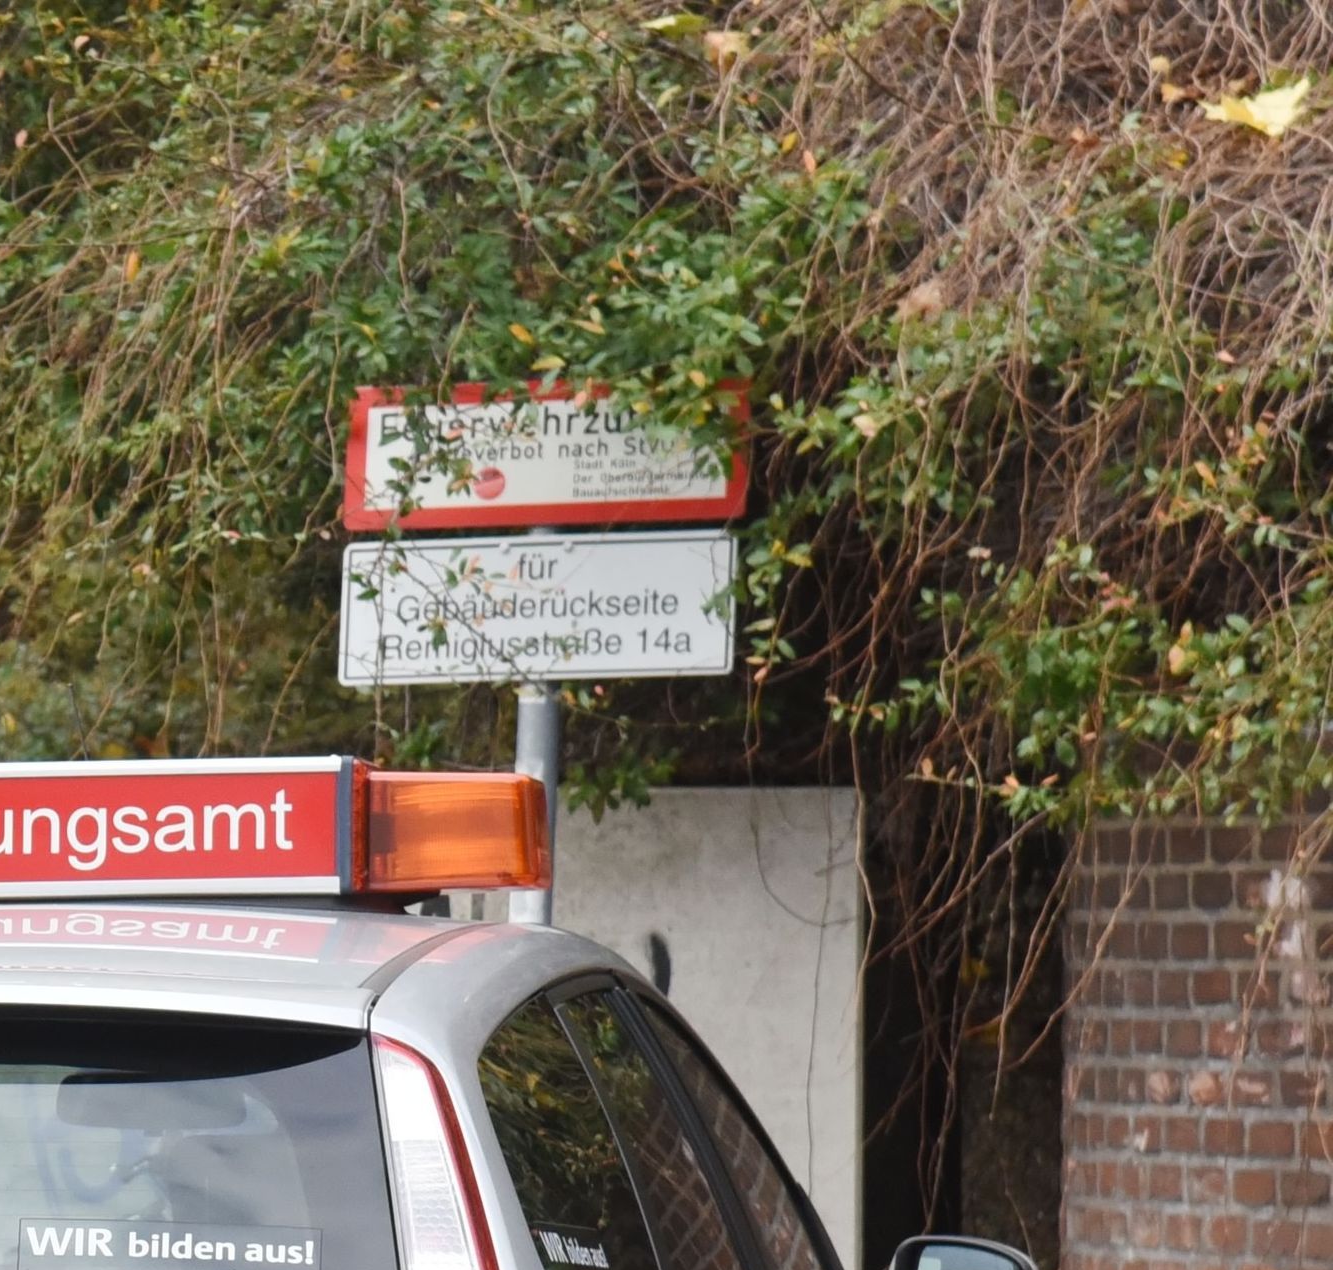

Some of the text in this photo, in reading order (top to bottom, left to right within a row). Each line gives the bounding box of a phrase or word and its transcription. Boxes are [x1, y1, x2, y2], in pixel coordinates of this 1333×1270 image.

[558, 438, 609, 458] nach
[518, 553, 558, 580] für
[396, 588, 680, 624] Gebäuderückseite
[636, 627, 692, 654] 14a
[26, 1226, 314, 1265] WIR bilden aus!
